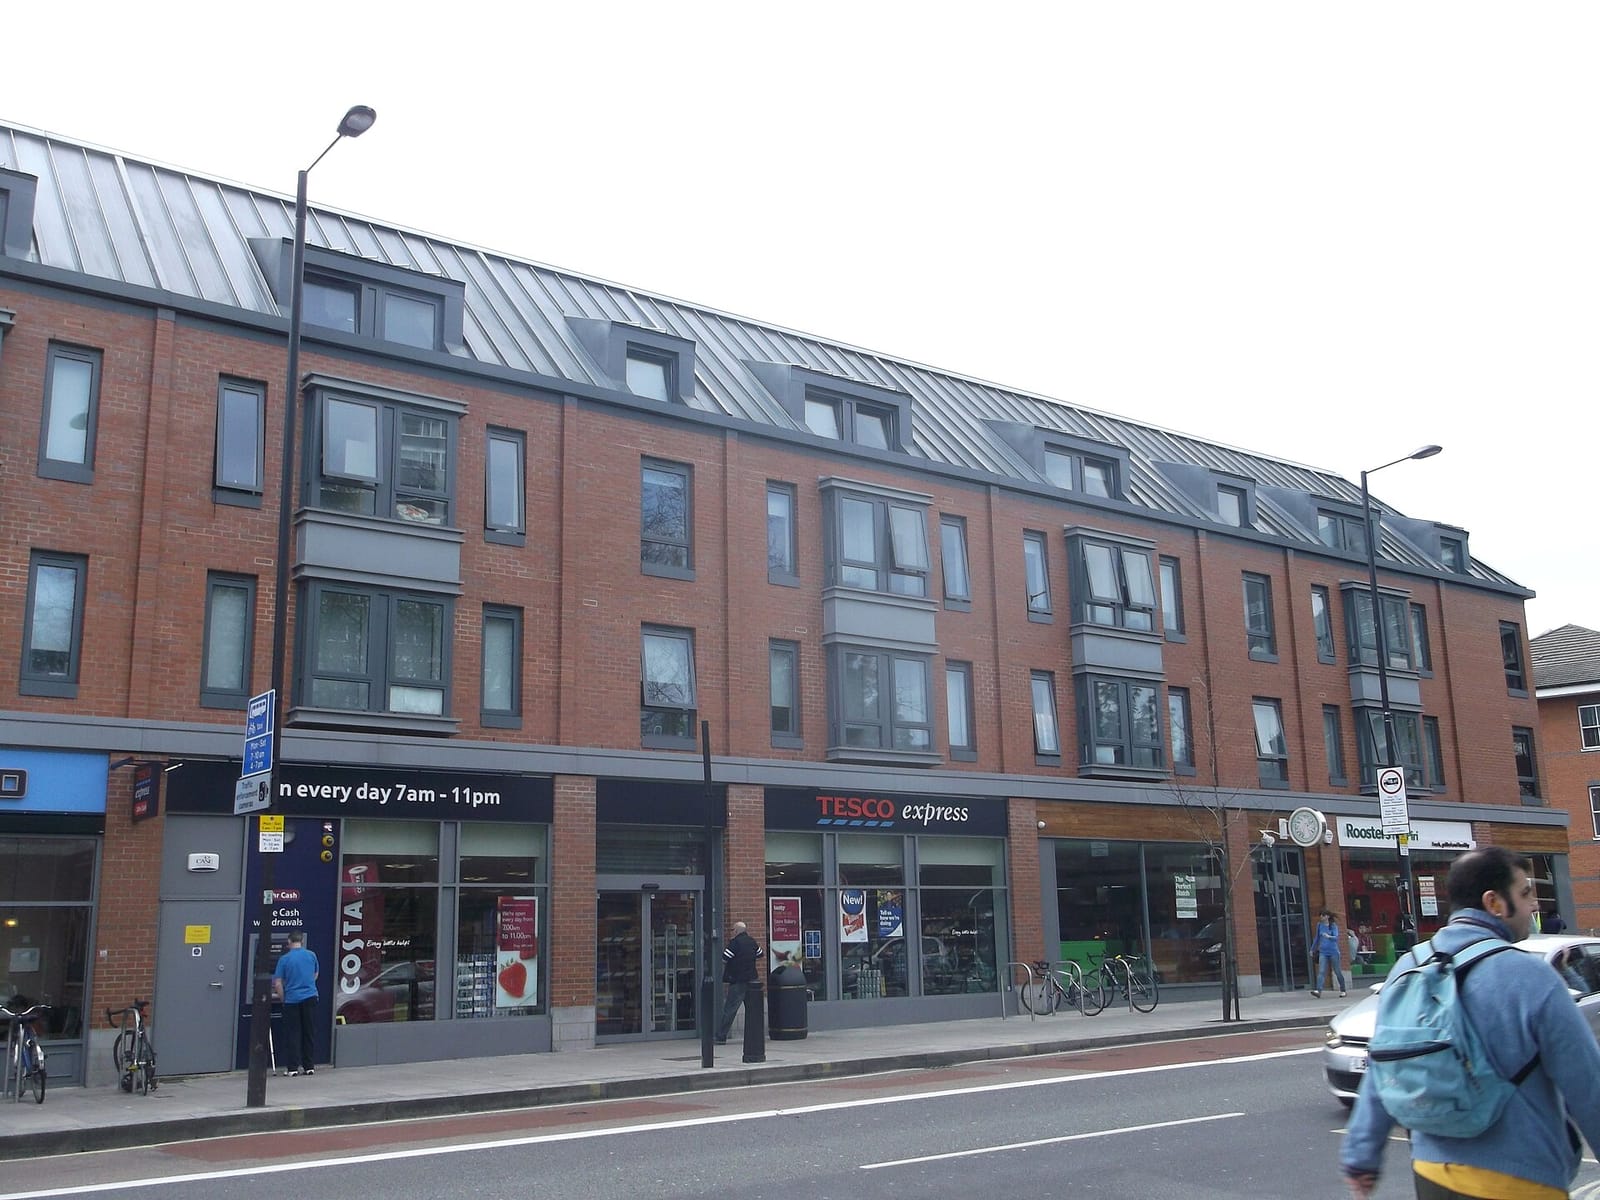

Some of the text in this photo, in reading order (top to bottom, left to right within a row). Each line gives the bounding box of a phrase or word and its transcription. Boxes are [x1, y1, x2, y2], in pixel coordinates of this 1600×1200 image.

[296, 784, 352, 803] every
[356, 782, 392, 805] day
[395, 784, 435, 802] 7am
[452, 786, 500, 808] 11pm
[816, 796, 969, 826] TESCO express
[843, 895, 863, 905] New!
[280, 908, 300, 917] Cash
[253, 918, 304, 927] wdrawals
[340, 900, 365, 994] COSTA
